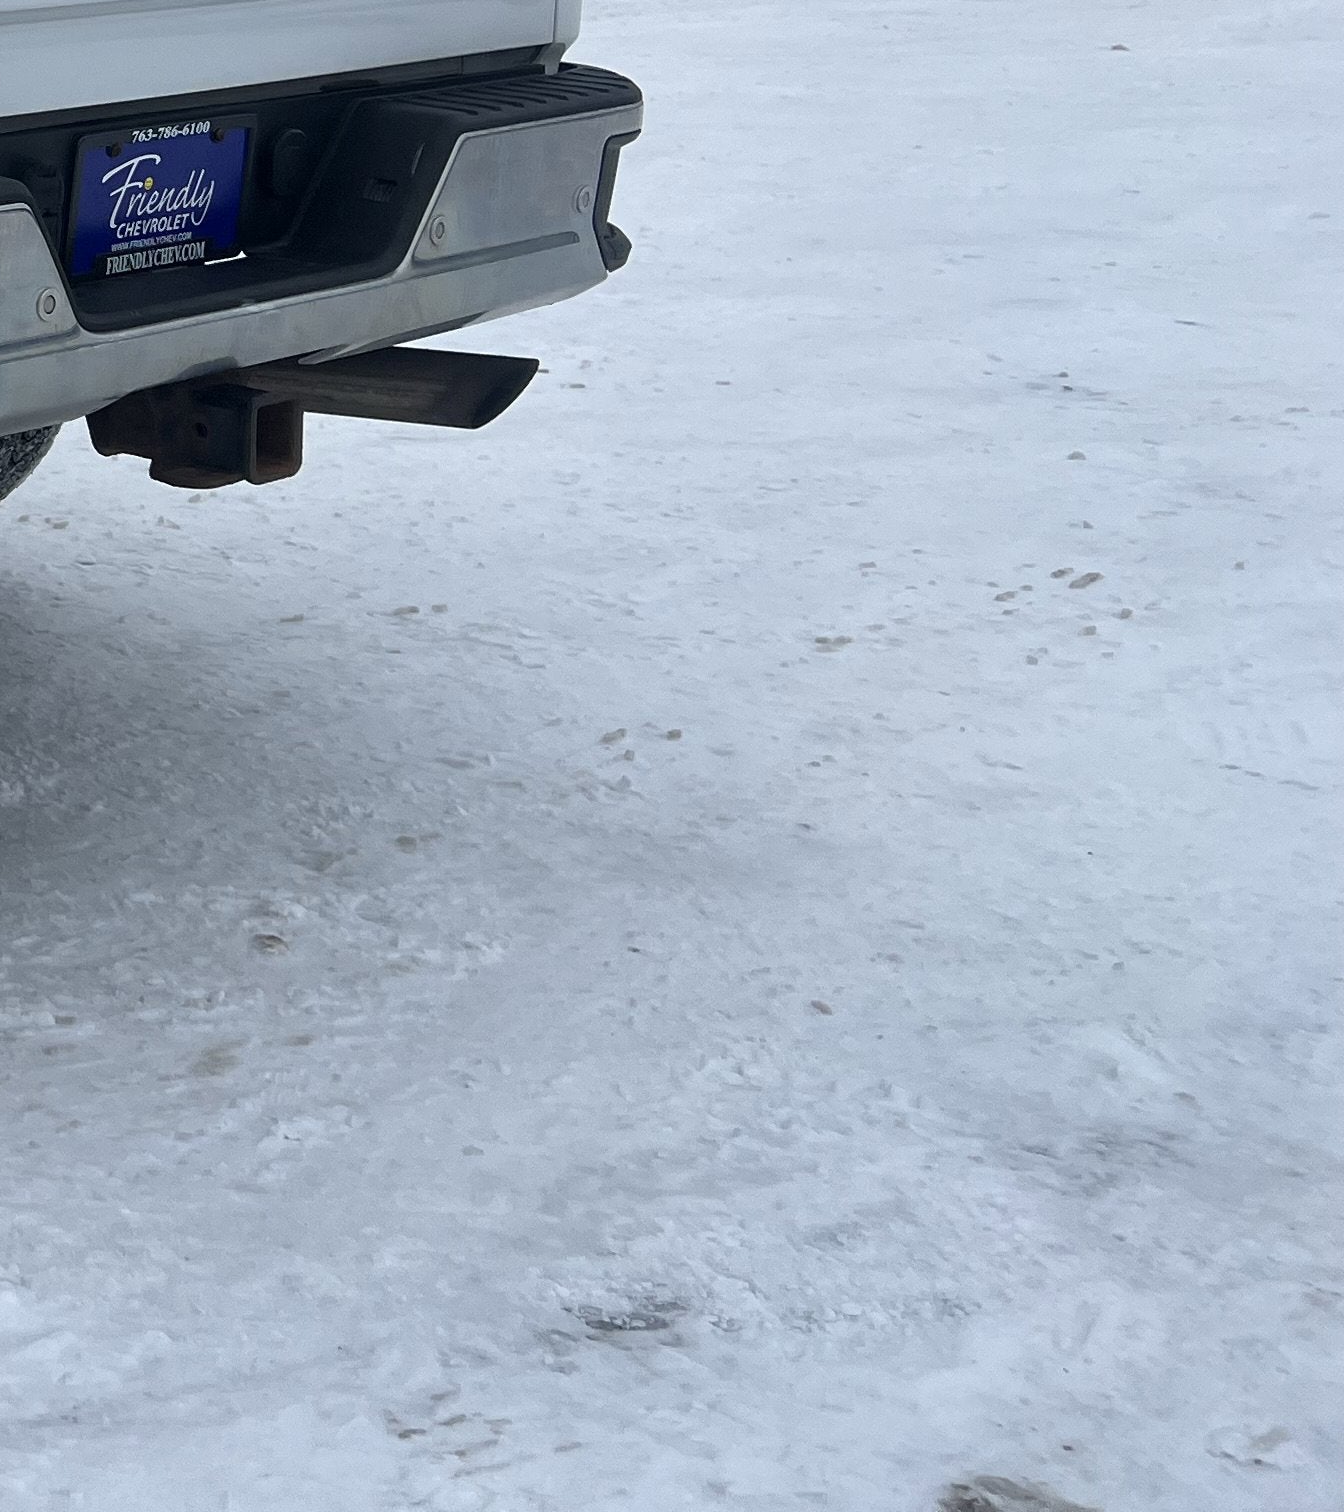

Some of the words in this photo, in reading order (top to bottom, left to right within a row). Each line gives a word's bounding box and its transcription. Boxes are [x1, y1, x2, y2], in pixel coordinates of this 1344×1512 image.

[132, 120, 211, 144] 763-786-6100
[101, 153, 215, 229] Friendly
[116, 213, 191, 239] CHEVROLET
[105, 240, 207, 276] FRIENDLYCHEV.COM
